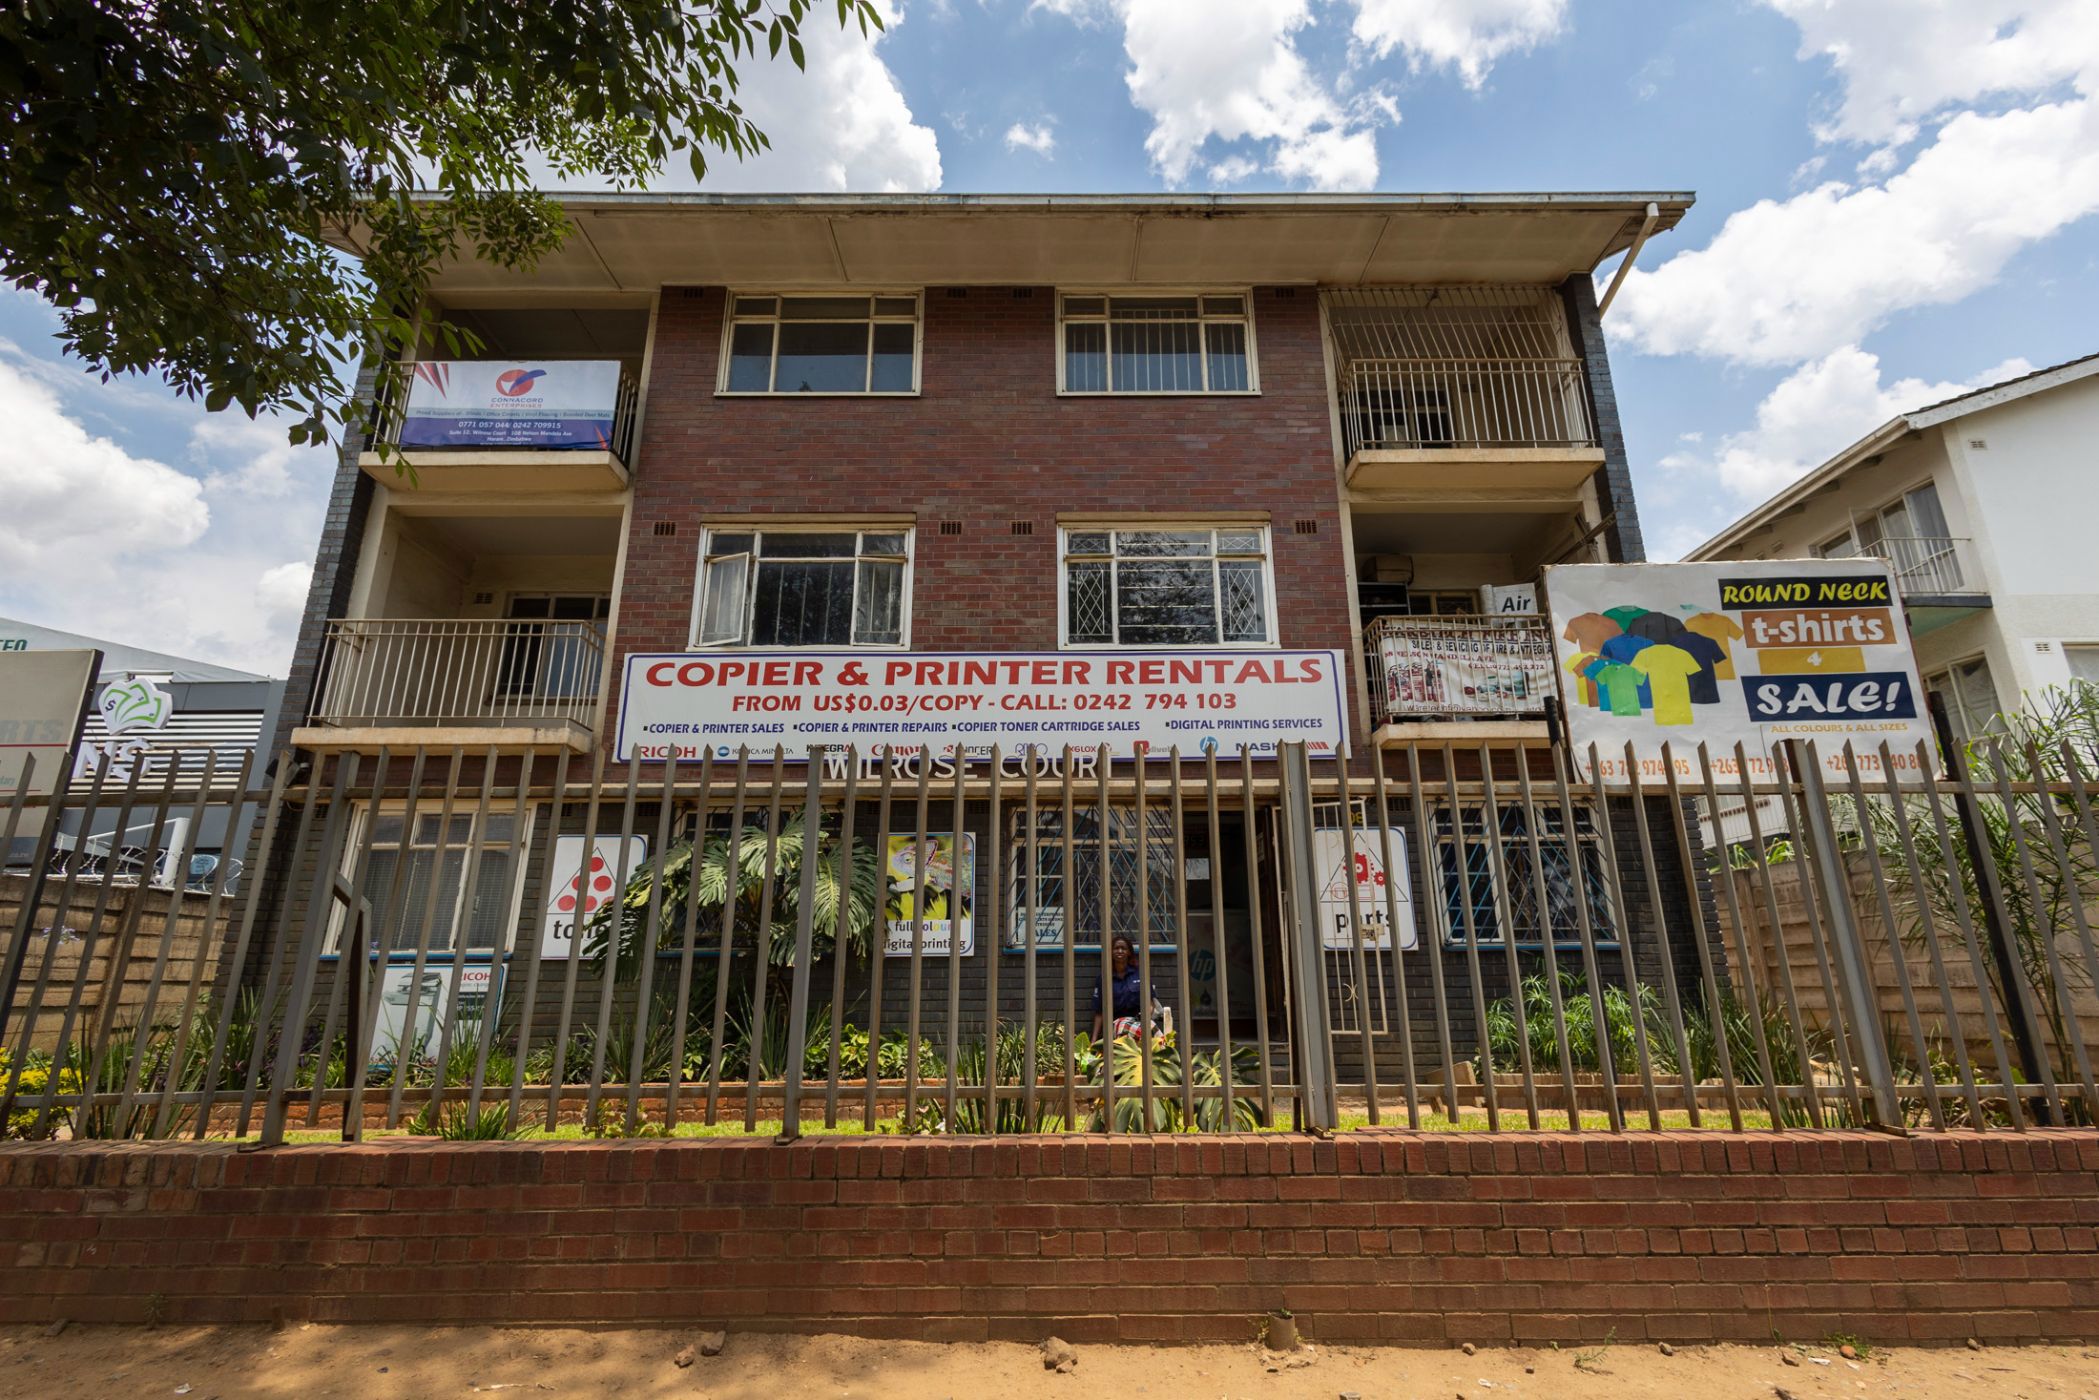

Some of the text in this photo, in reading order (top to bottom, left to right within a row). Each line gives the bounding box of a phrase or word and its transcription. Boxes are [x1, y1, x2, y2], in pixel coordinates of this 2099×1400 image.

[512, 421, 532, 429] 0242
[1723, 582, 1888, 603] ROUND NECK
[1502, 596, 1531, 612] Air
[1752, 613, 1885, 644] t-shirts
[646, 659, 1322, 687] COPIER & PRINTER RENTALS
[732, 696, 802, 712] FROM
[813, 693, 984, 716] US$0.03/COPY
[1001, 694, 1067, 710] CALL:
[1073, 694, 1132, 710] 0242
[1144, 694, 1188, 710] 794
[1196, 693, 1237, 709] 103
[1757, 681, 1901, 715] SALE!
[649, 723, 784, 734] COPIER & PRINTER SALES
[798, 722, 948, 732] COPIER & PRINTER REPAIRS
[957, 720, 1140, 732] COPIER TONER CARTRIDGE SALES
[1170, 718, 1322, 730] DIGITAL PRINTING SERVICES
[1771, 722, 1909, 733] ALL COLOURS & ALL SIZES
[871, 744, 924, 757] Cnon
